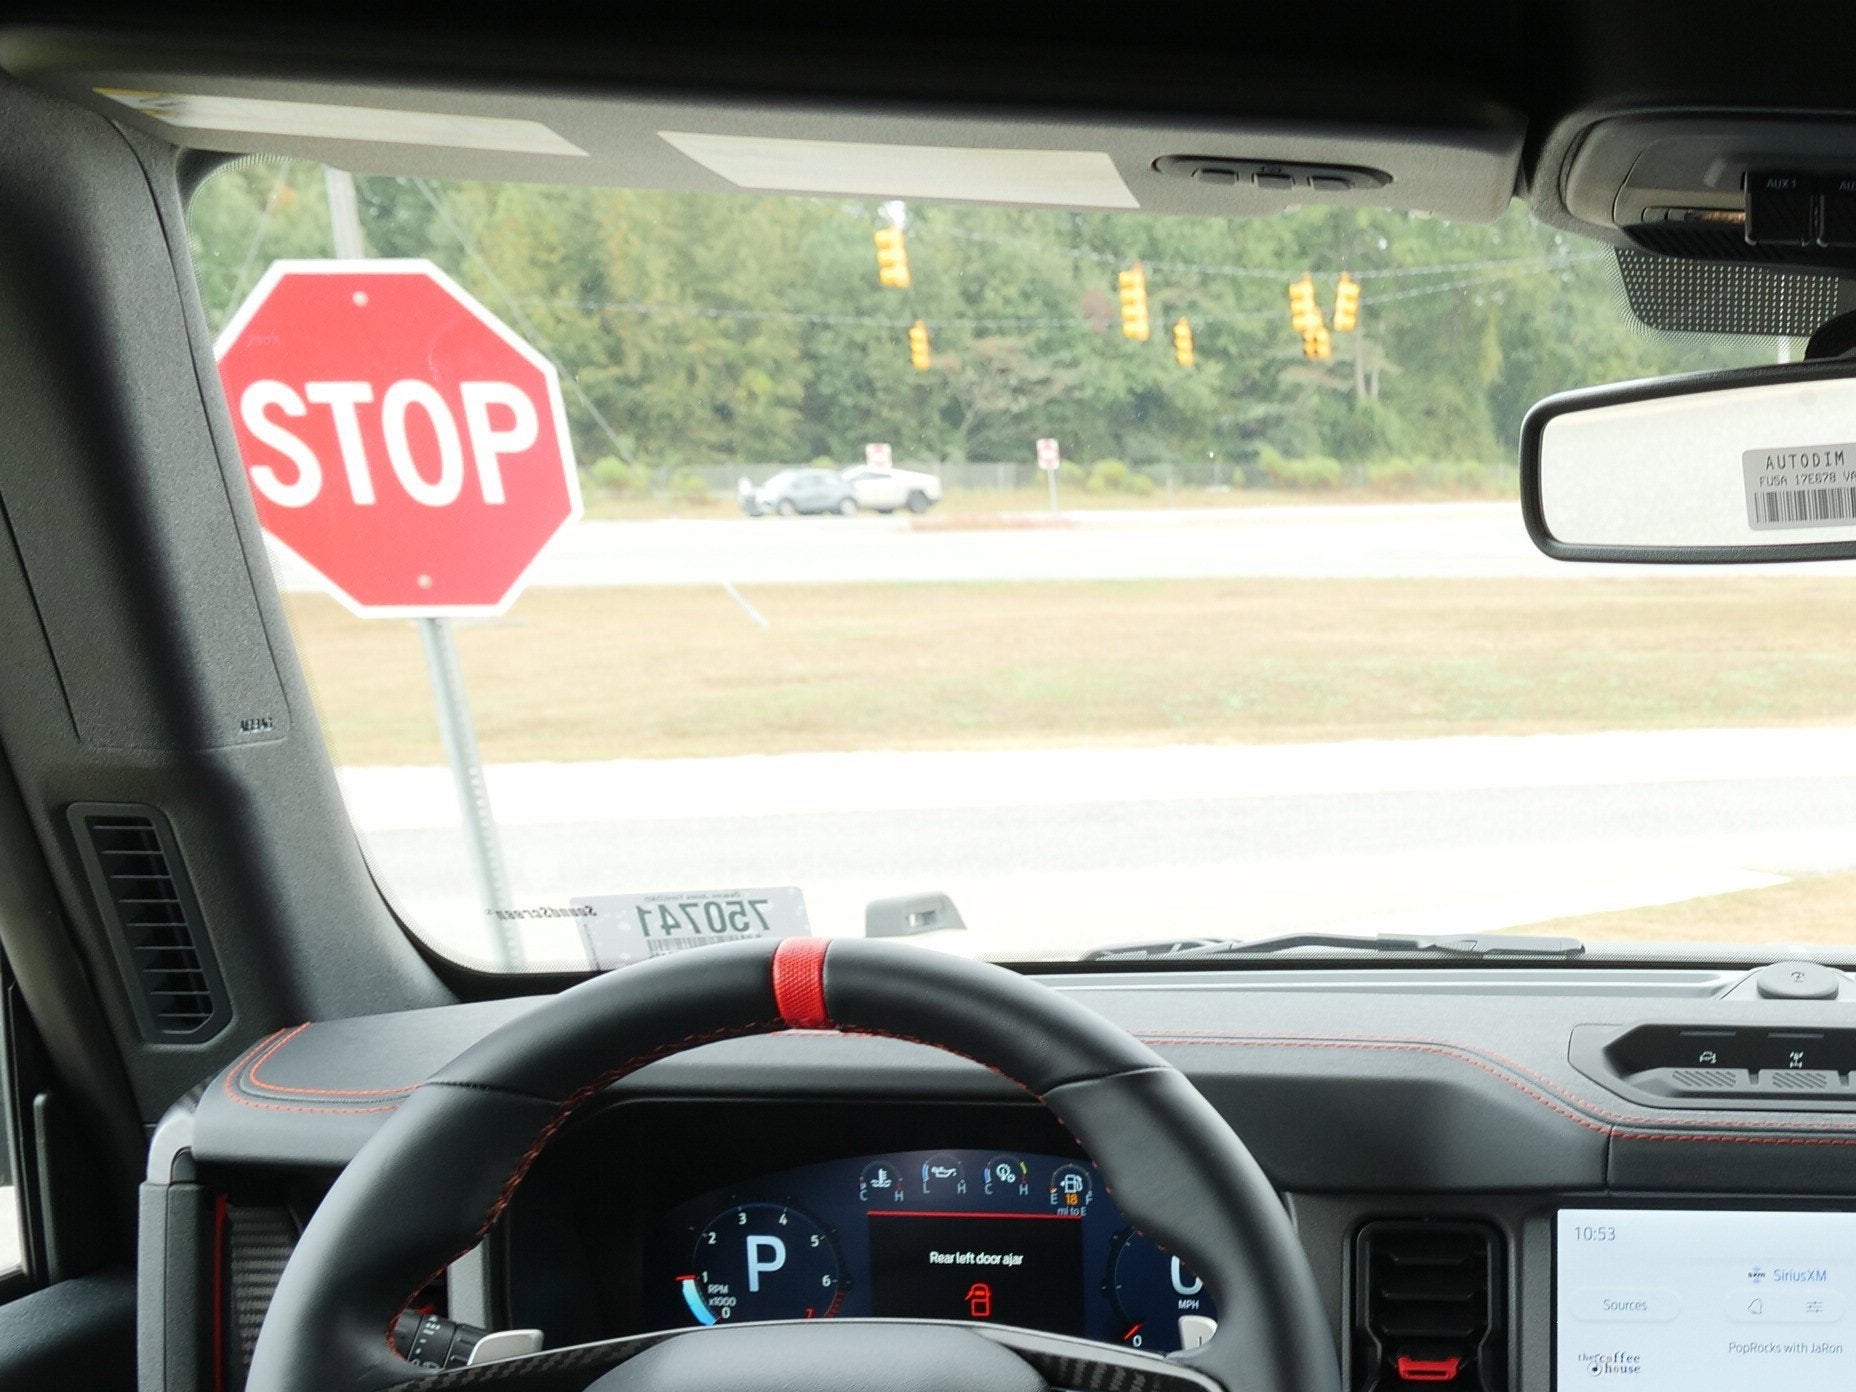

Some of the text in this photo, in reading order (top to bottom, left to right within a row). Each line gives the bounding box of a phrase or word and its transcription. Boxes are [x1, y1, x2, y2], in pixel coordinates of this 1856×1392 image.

[238, 377, 541, 508] STOP
[1765, 449, 1845, 471] AUTODIM
[859, 1189, 869, 1202] C
[983, 1183, 993, 1196] C
[1065, 1193, 1079, 1206] 18
[738, 1212, 747, 1226] 3
[1069, 1207, 1080, 1217] to
[778, 1213, 788, 1226] 4
[707, 1231, 717, 1245] 2
[809, 1234, 821, 1247] 5
[1573, 1225, 1617, 1242] 10:53
[745, 1234, 787, 1293] P
[929, 1251, 1024, 1267] Rear left door ajar
[701, 1270, 709, 1284] 1
[821, 1274, 832, 1288] 6
[1772, 1267, 1828, 1283] SiriusXM
[707, 1283, 730, 1296] RPM
[1177, 1299, 1200, 1310] MPH
[1602, 1298, 1649, 1312] Sources
[721, 1307, 731, 1319] 0
[1132, 1334, 1143, 1348] 0
[1727, 1341, 1782, 1356] PopRocks
[1782, 1341, 1808, 1354] with
[1599, 1352, 1642, 1365] coffee
[1603, 1362, 1642, 1375] house
